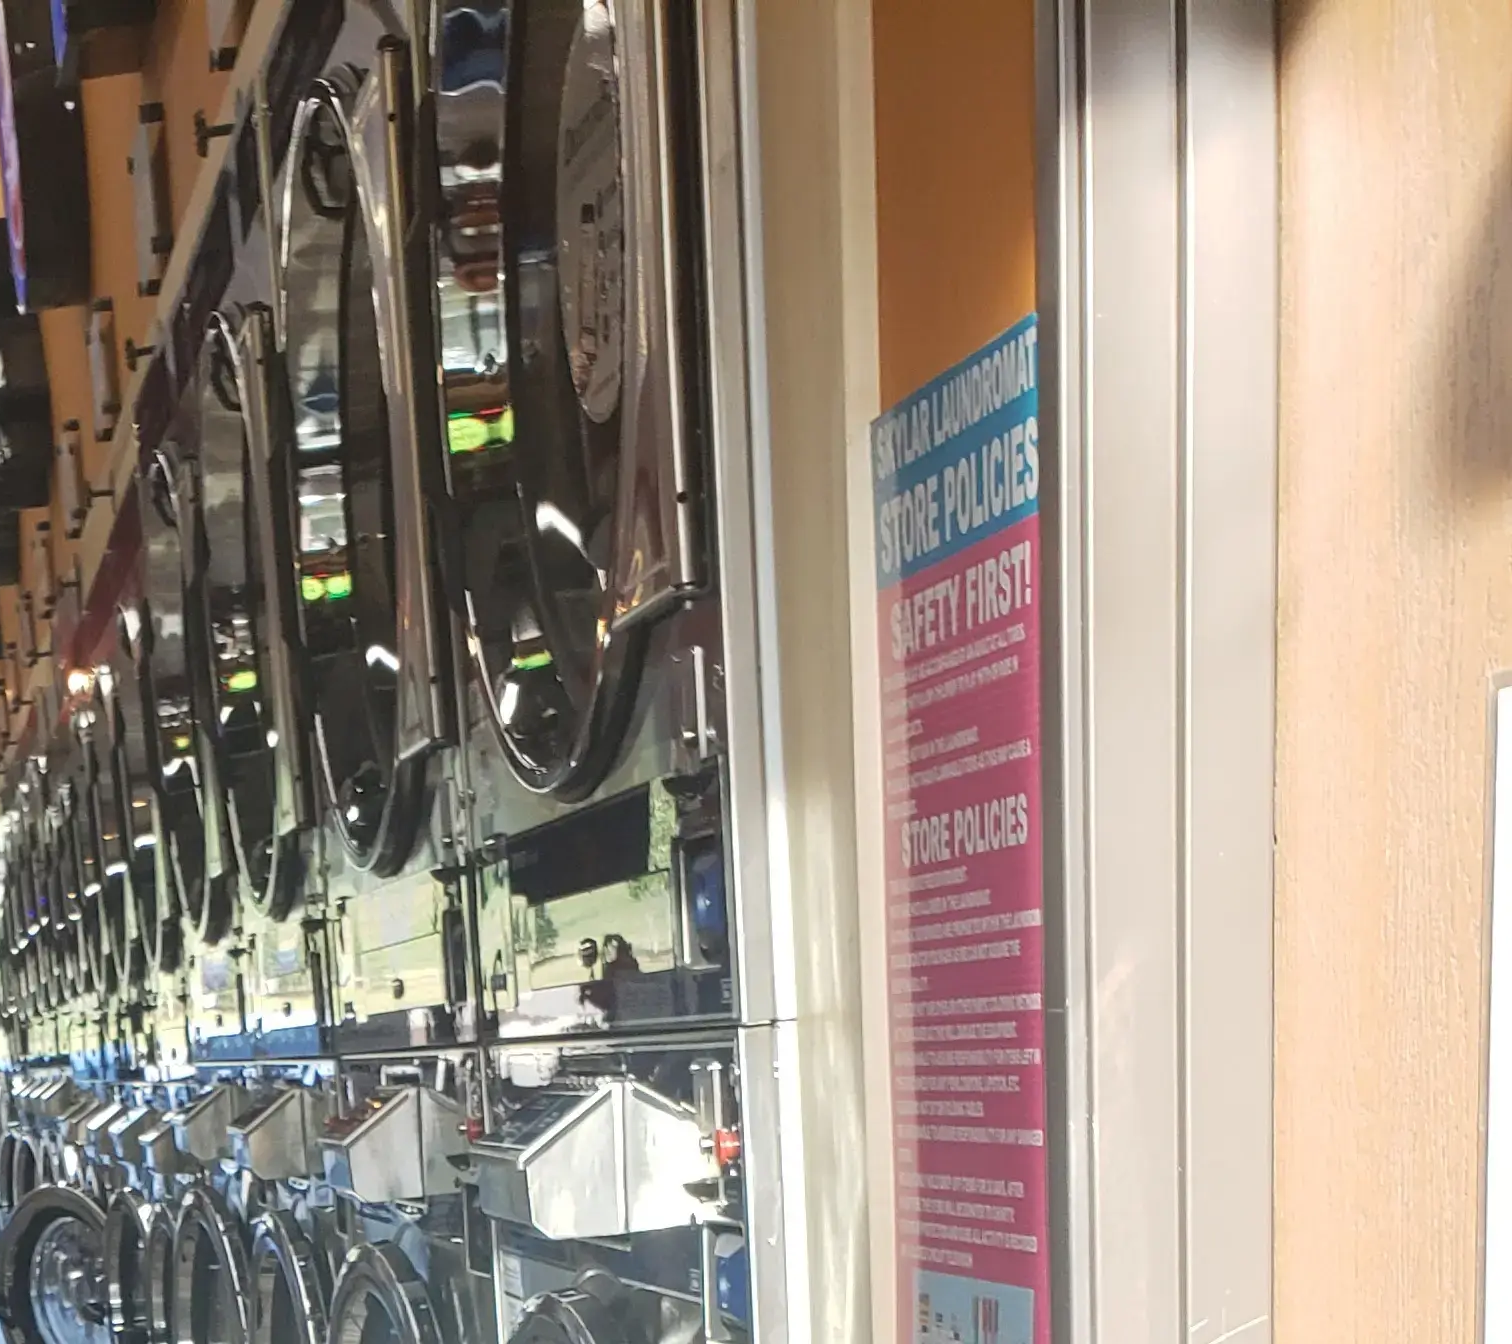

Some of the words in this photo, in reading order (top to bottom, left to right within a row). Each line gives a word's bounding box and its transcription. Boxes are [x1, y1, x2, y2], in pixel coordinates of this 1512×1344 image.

[933, 326, 1037, 447] LAUNDROMAT
[881, 477, 940, 574] STORE
[945, 417, 1039, 542] POLICIES
[890, 575, 960, 660] SAFETY
[966, 541, 1031, 629] FIRST!
[901, 813, 950, 868] STORE
[954, 793, 1028, 857] POLICIES
